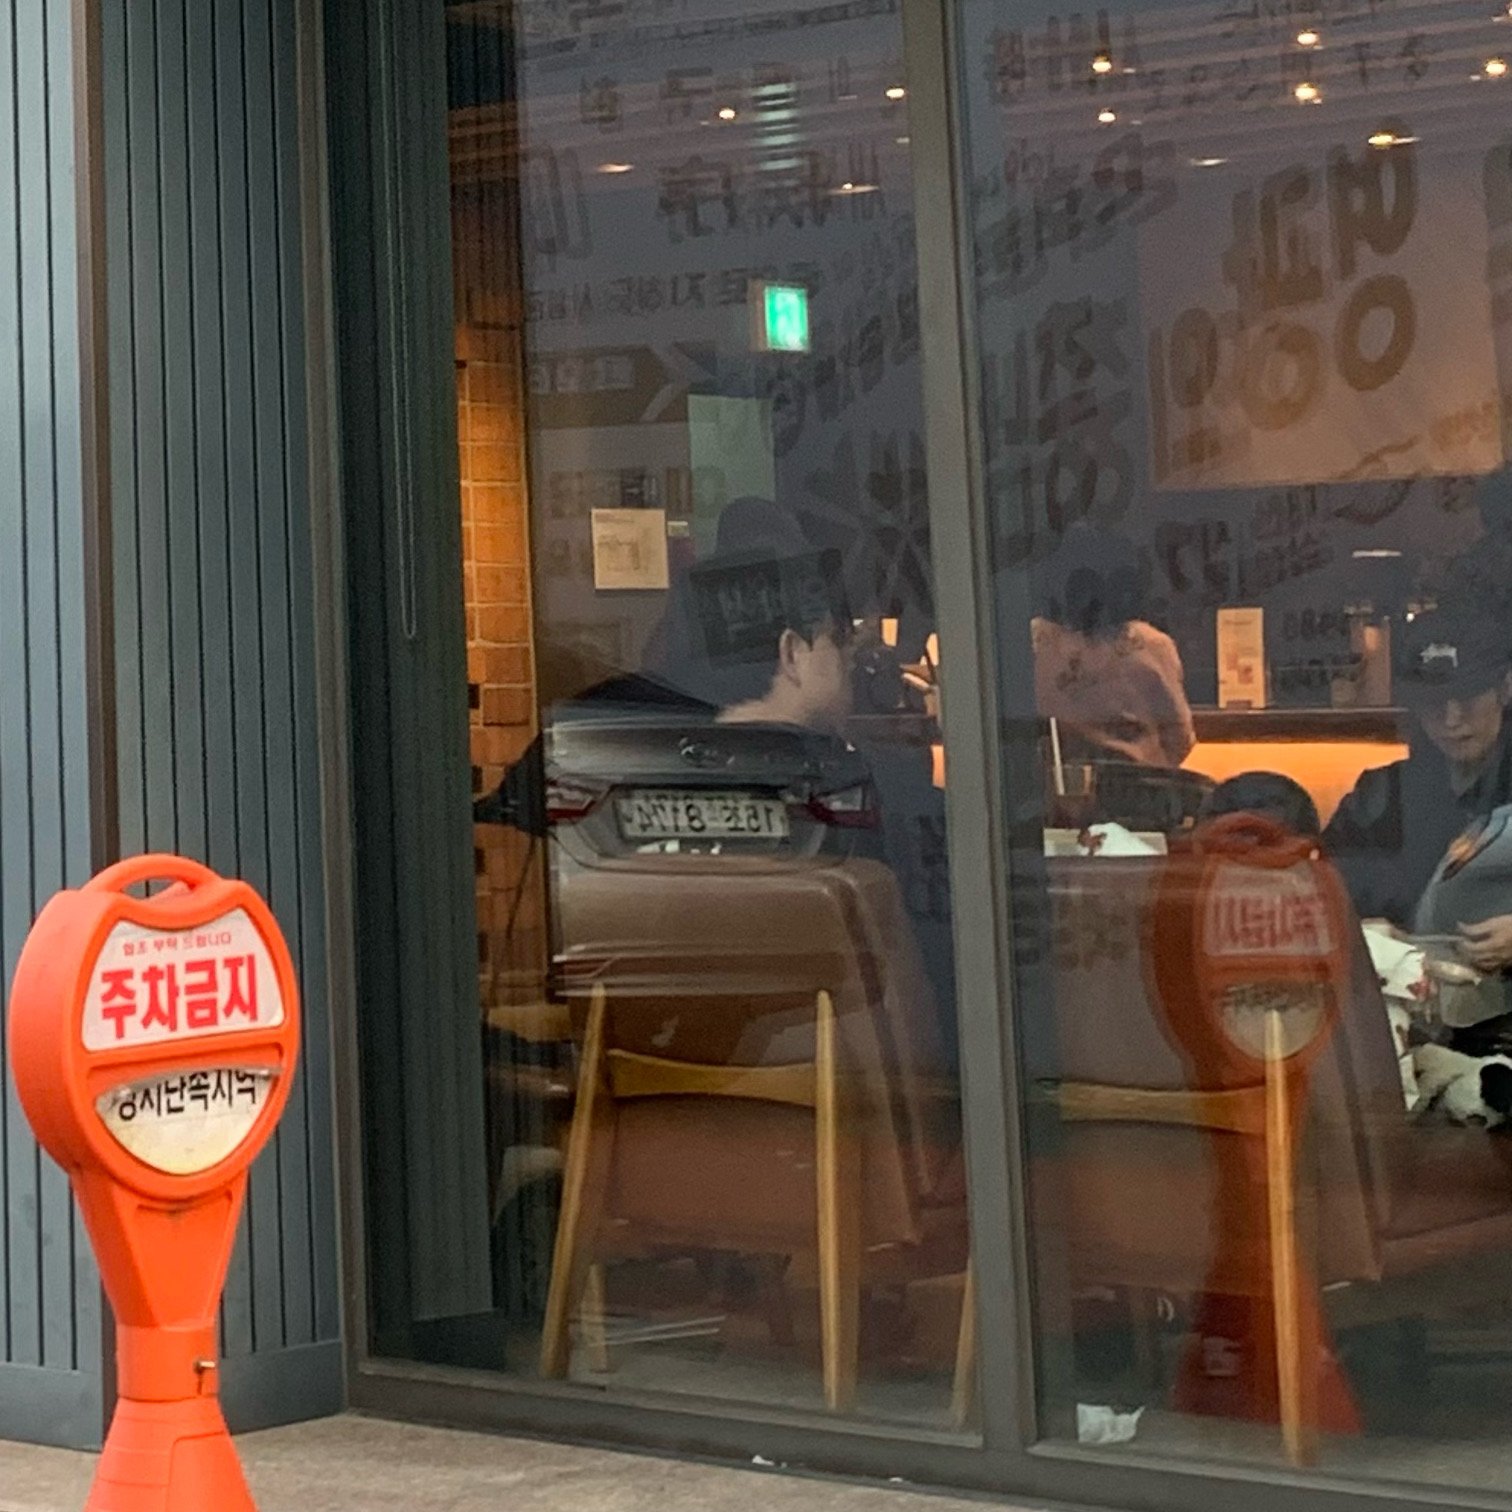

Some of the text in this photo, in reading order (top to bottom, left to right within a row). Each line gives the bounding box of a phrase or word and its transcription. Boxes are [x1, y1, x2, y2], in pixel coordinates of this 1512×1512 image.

[153, 937, 178, 952] 부탁
[183, 932, 232, 949] 드립니다
[101, 954, 258, 1039] 주차금지
